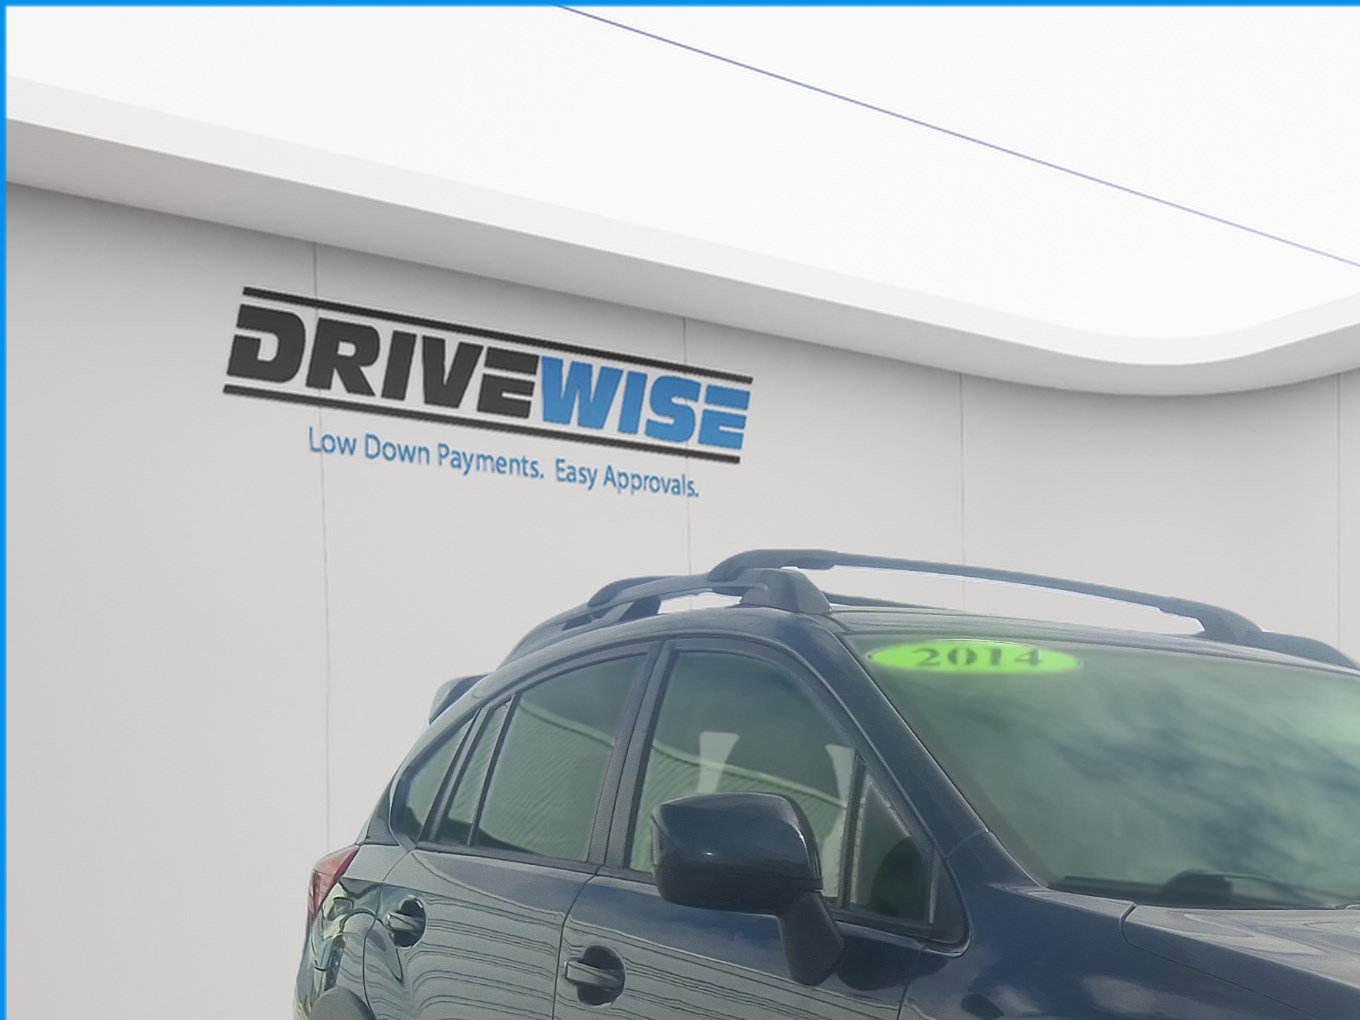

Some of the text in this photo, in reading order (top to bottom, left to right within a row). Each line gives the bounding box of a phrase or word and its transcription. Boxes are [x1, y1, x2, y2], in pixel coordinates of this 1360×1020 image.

[226, 303, 750, 450] DRIVEWISE
[308, 426, 701, 499] Low Down Payments. Easy Approvals.
[912, 646, 1045, 668] 2014
